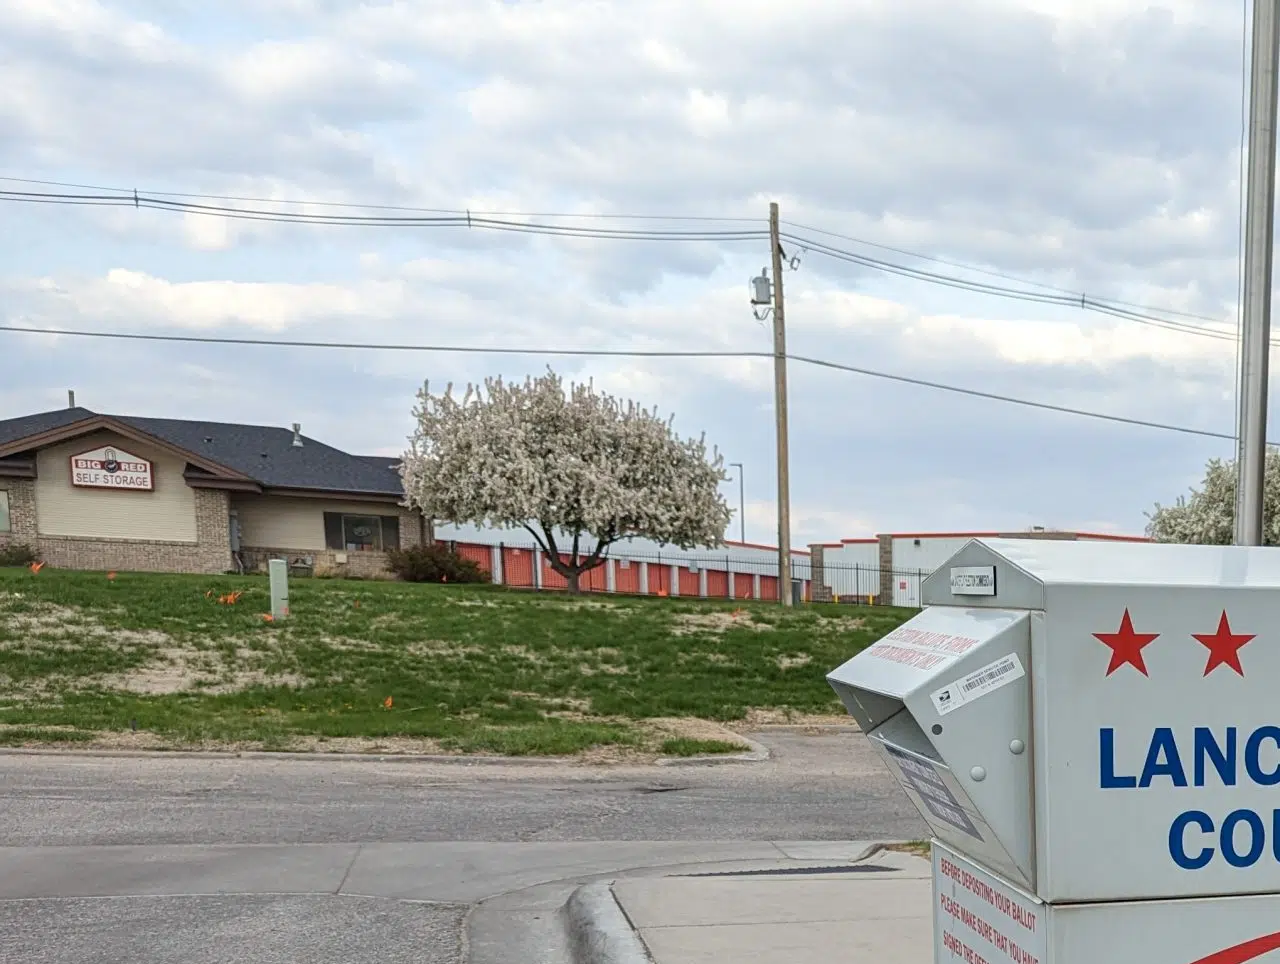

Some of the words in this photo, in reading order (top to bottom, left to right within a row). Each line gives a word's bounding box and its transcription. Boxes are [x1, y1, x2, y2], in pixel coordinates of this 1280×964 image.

[76, 473, 100, 483] SELF
[103, 475, 148, 486] STORAGE
[78, 461, 101, 469] BIG
[122, 463, 145, 472] RED
[941, 857, 961, 885] BEFORE
[961, 870, 994, 905] DEPOSITING
[994, 890, 1011, 916] YOUR
[1012, 901, 1036, 933] BALLOT
[940, 893, 961, 920] PLEASE
[961, 906, 977, 932] MAKE
[978, 918, 993, 944] SURE
[993, 928, 1008, 954] THAT
[1008, 940, 1022, 964] YOU
[943, 930, 963, 957] SIGNED
